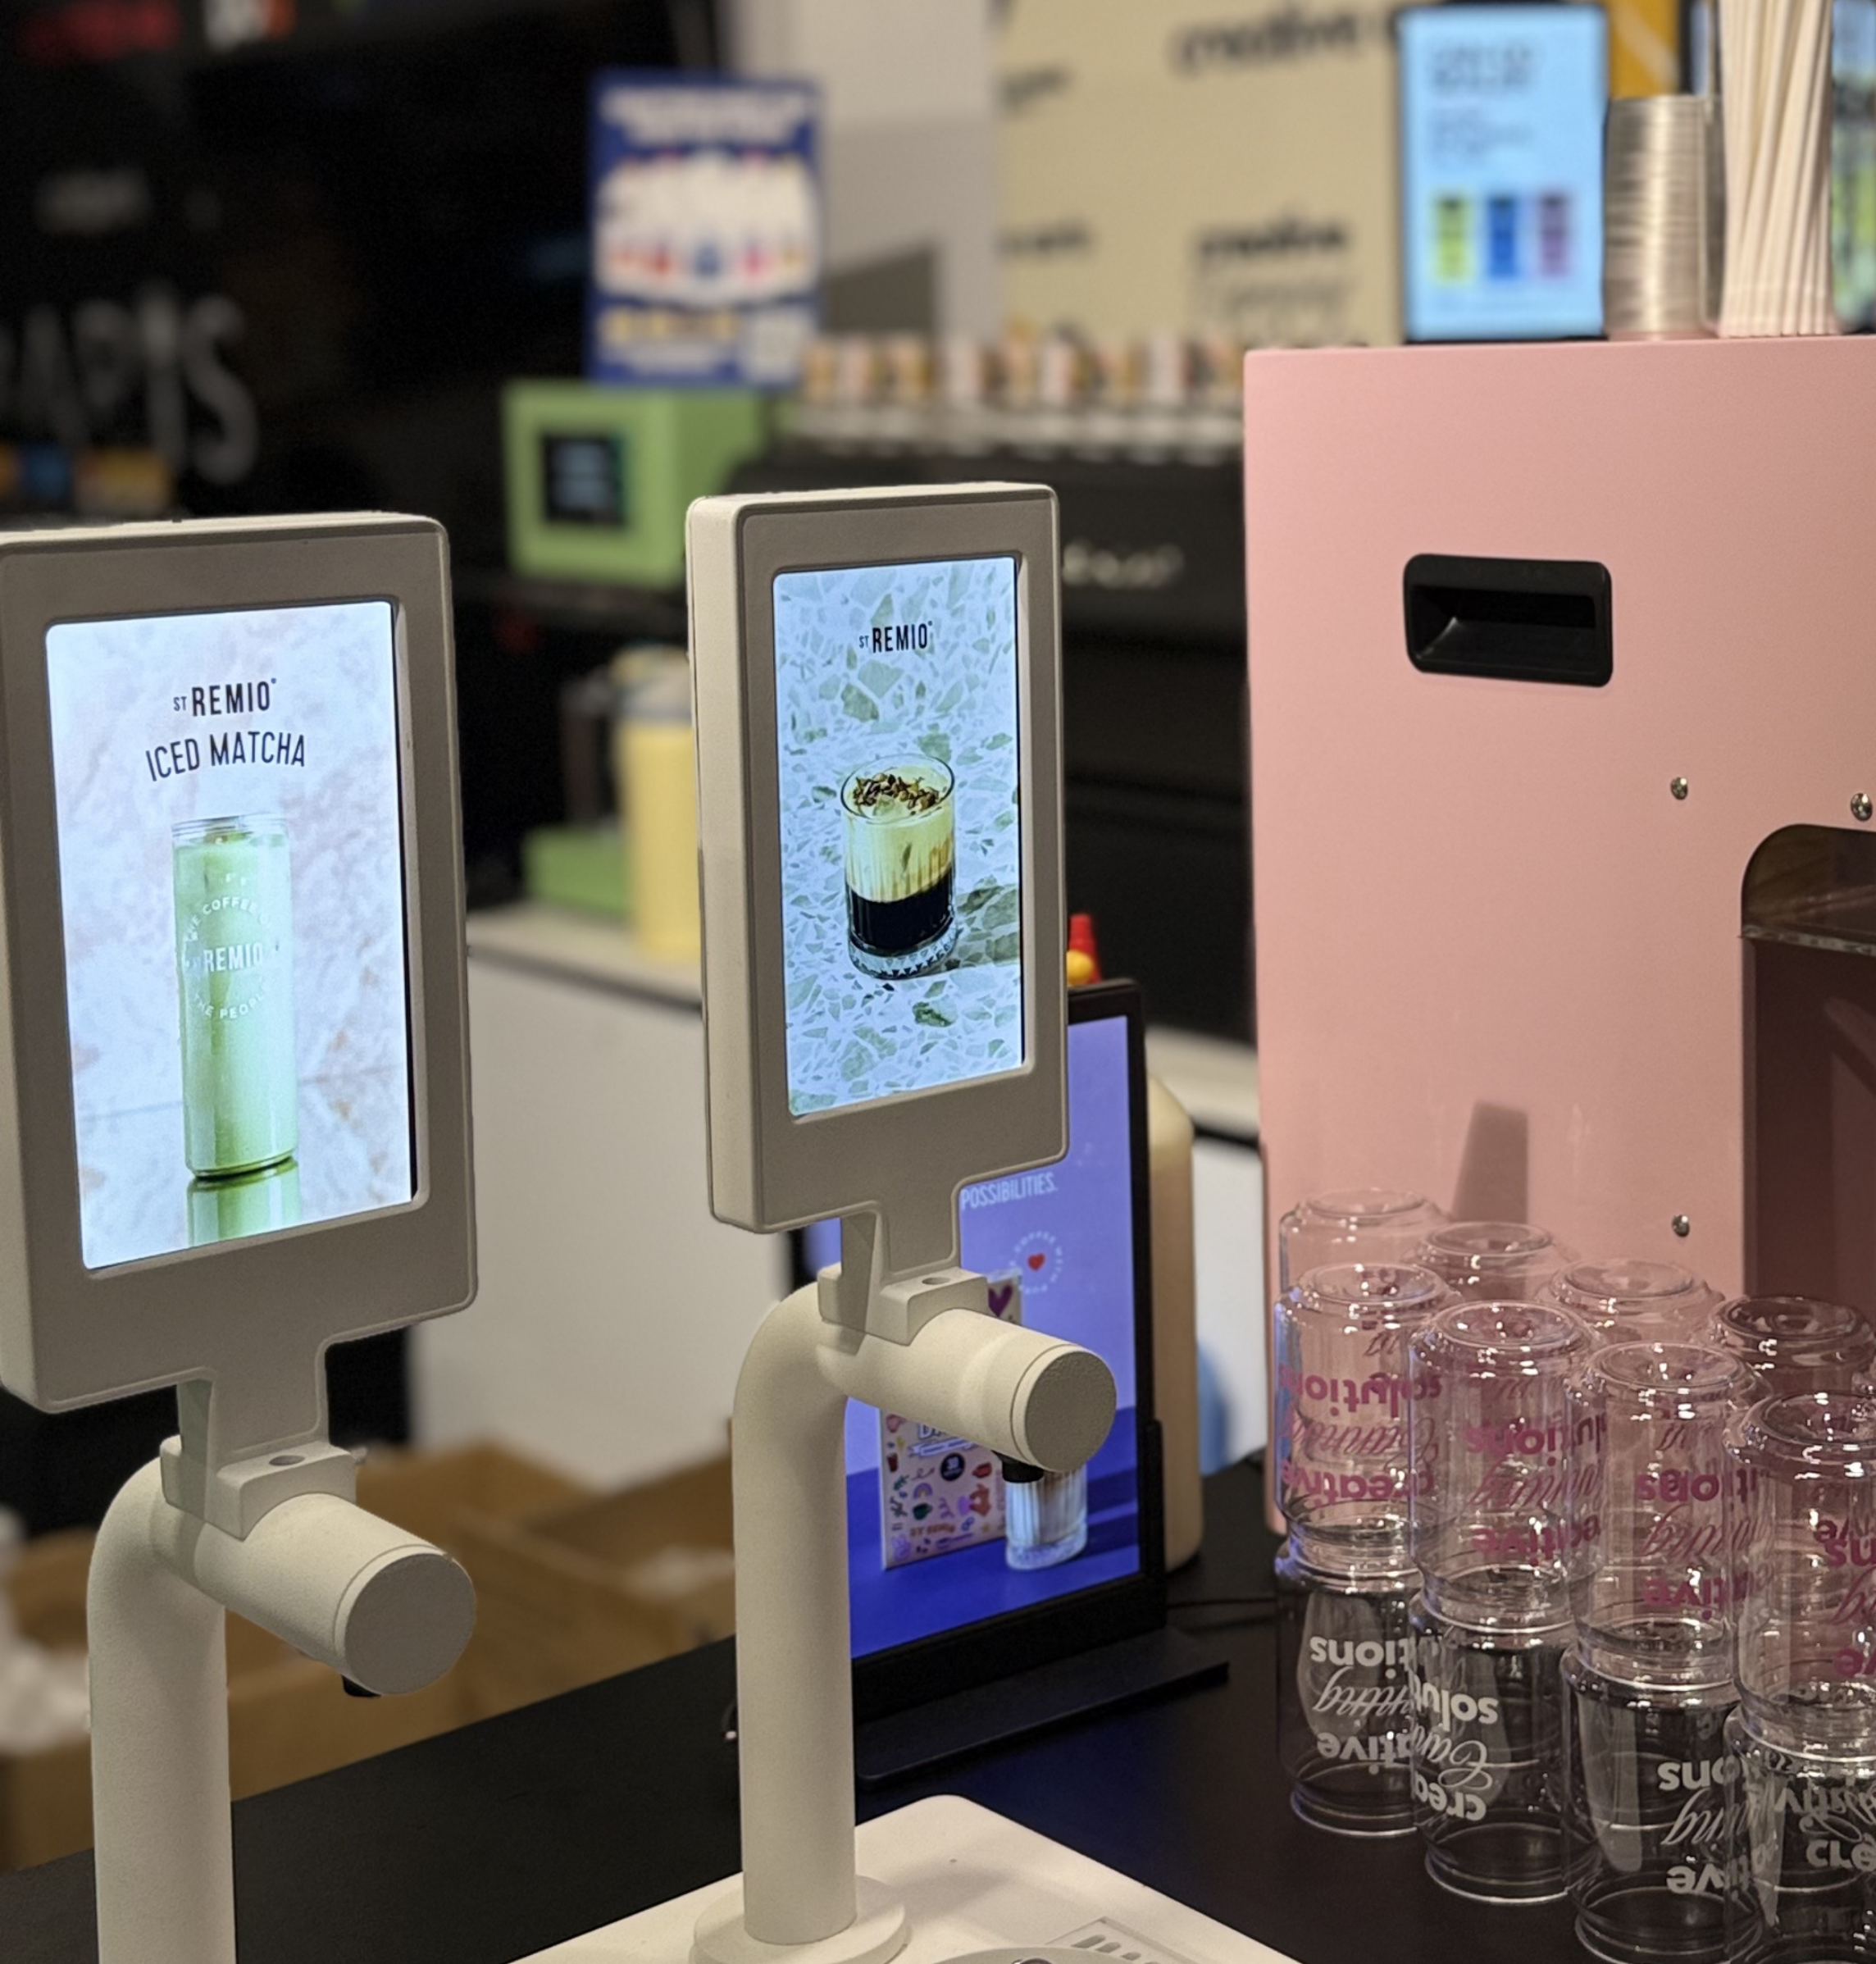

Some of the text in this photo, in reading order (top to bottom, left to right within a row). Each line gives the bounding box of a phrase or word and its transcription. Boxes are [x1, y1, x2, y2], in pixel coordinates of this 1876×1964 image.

[859, 623, 927, 654] ST REMIO
[173, 681, 271, 717] ST REMIO
[145, 731, 305, 781] ICED MATCHA
